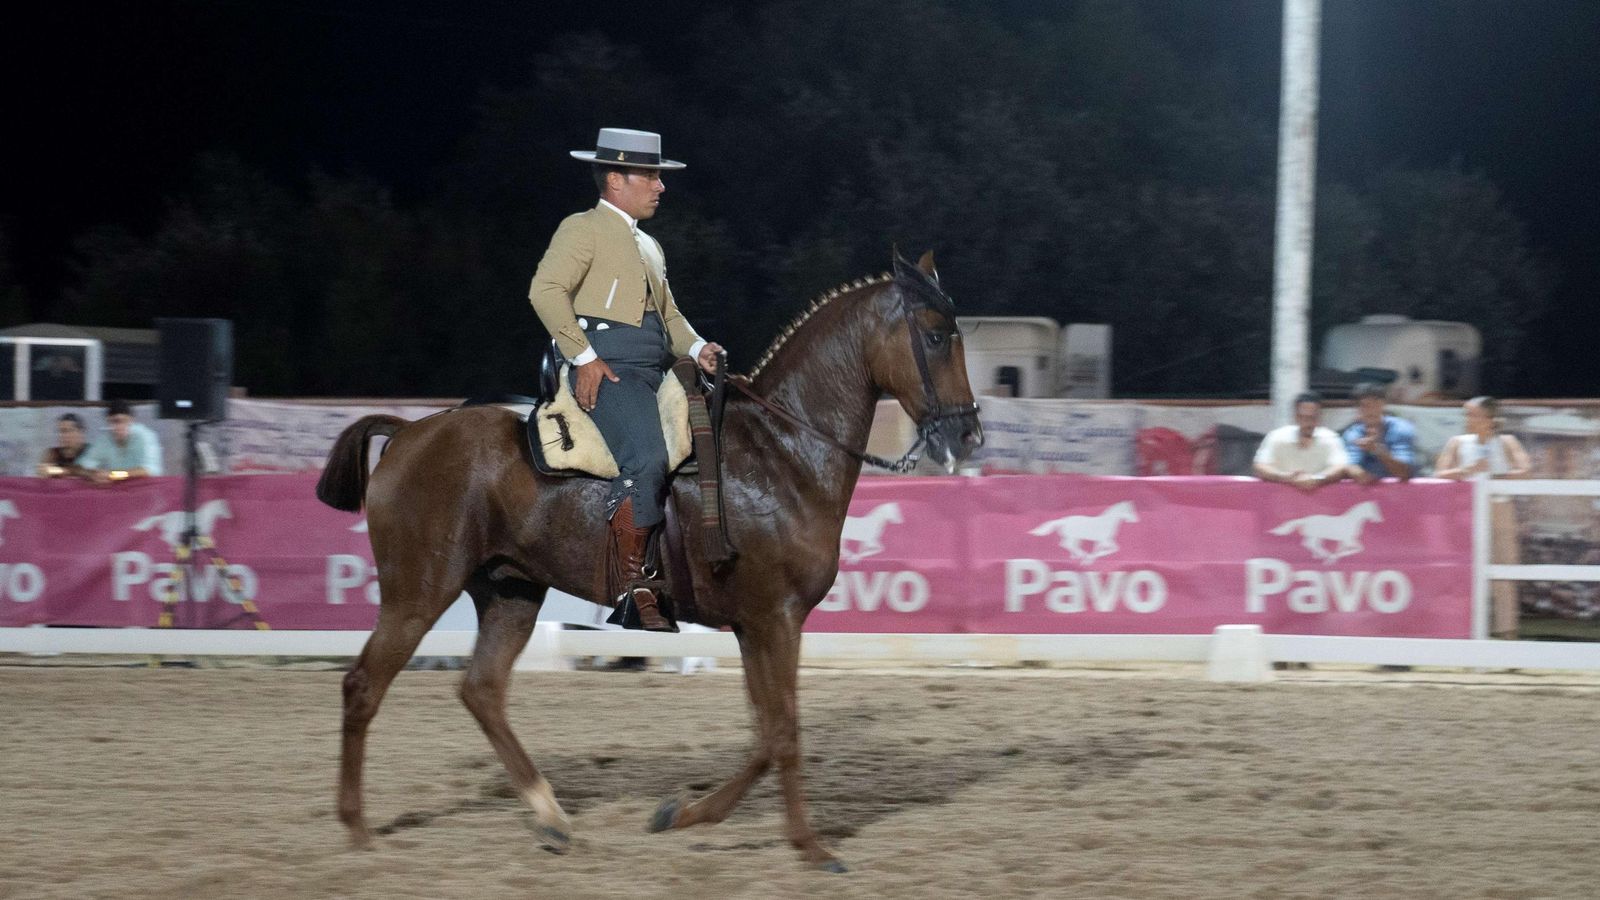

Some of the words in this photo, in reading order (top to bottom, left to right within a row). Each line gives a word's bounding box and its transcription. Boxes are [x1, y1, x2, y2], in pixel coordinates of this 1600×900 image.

[112, 551, 258, 604] Pavo
[814, 570, 929, 613] avo
[1003, 558, 1168, 614] Pavo
[1244, 557, 1413, 614] Pavo
